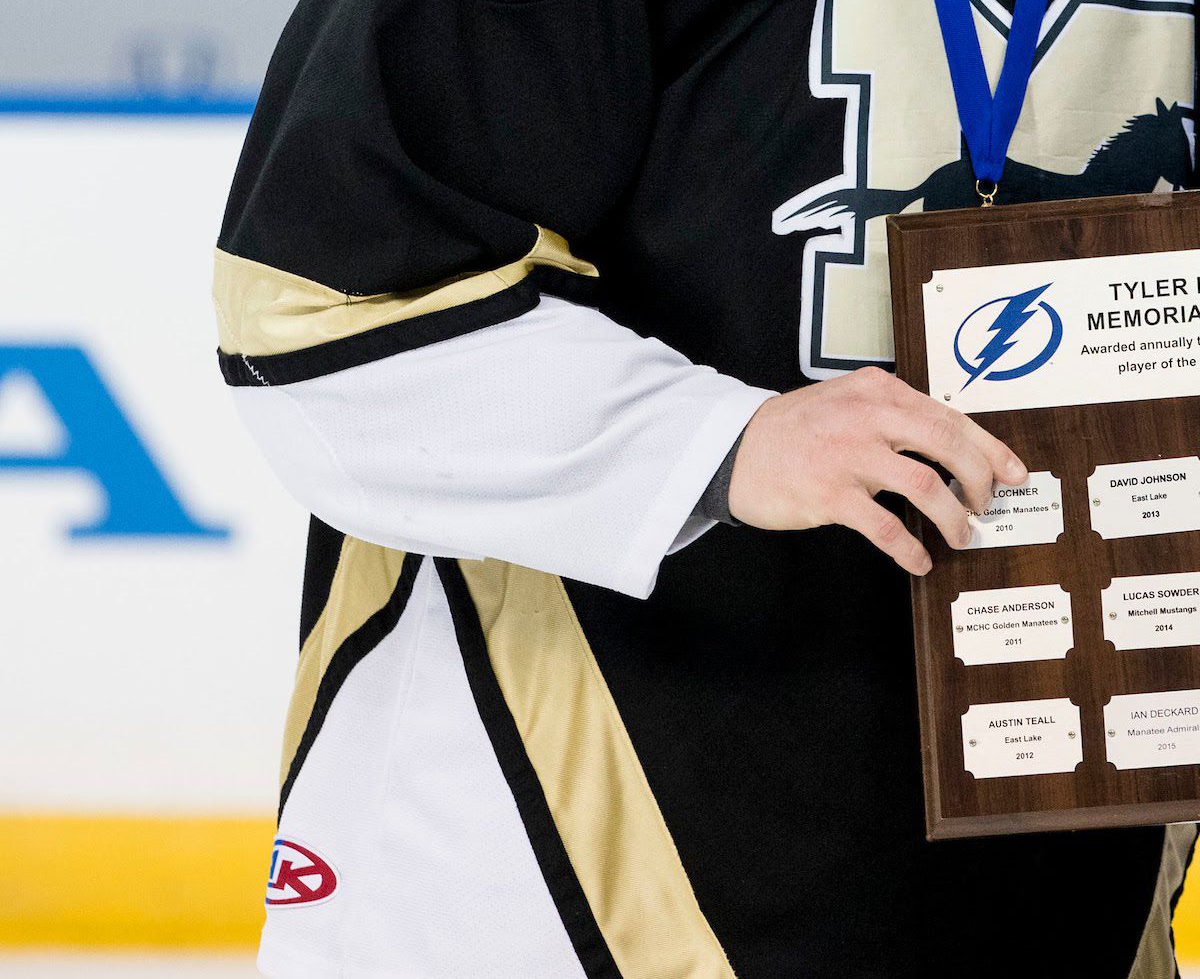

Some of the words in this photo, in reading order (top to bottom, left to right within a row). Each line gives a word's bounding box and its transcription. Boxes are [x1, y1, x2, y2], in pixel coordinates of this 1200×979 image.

[1108, 278, 1188, 300] TYLER
[1080, 341, 1136, 355] Awarded
[1140, 336, 1193, 350] annually
[1118, 360, 1157, 374] player
[1160, 358, 1174, 369] of
[1176, 356, 1196, 367] the
[1110, 478, 1138, 488] DAVID
[1140, 472, 1186, 485] JOHNSON
[992, 488, 1038, 498] LOCHNER
[1132, 494, 1148, 502] East
[1150, 492, 1168, 500] Lake
[984, 508, 1010, 516] Golden
[1012, 505, 1049, 513] Manatees
[1142, 510, 1160, 519] 2013
[1123, 591, 1155, 601] LUCAS
[1158, 588, 1200, 598] SOWDER
[968, 606, 1000, 615] CHASE
[1002, 601, 1055, 612] ANDERSON
[1128, 608, 1158, 617] Mitchell
[1160, 606, 1197, 615] Mustangs
[966, 623, 990, 632] MCHC
[992, 622, 1020, 630] Golden
[1022, 618, 1058, 627] Manatees
[1130, 710, 1148, 720] IAN
[1150, 706, 1199, 718] DECKARD
[988, 718, 1023, 728] AUSTIN
[1025, 716, 1056, 726] TEALL
[1023, 734, 1042, 742] Lake
[1127, 728, 1164, 736] Manatee
[1016, 752, 1034, 760] 2012
